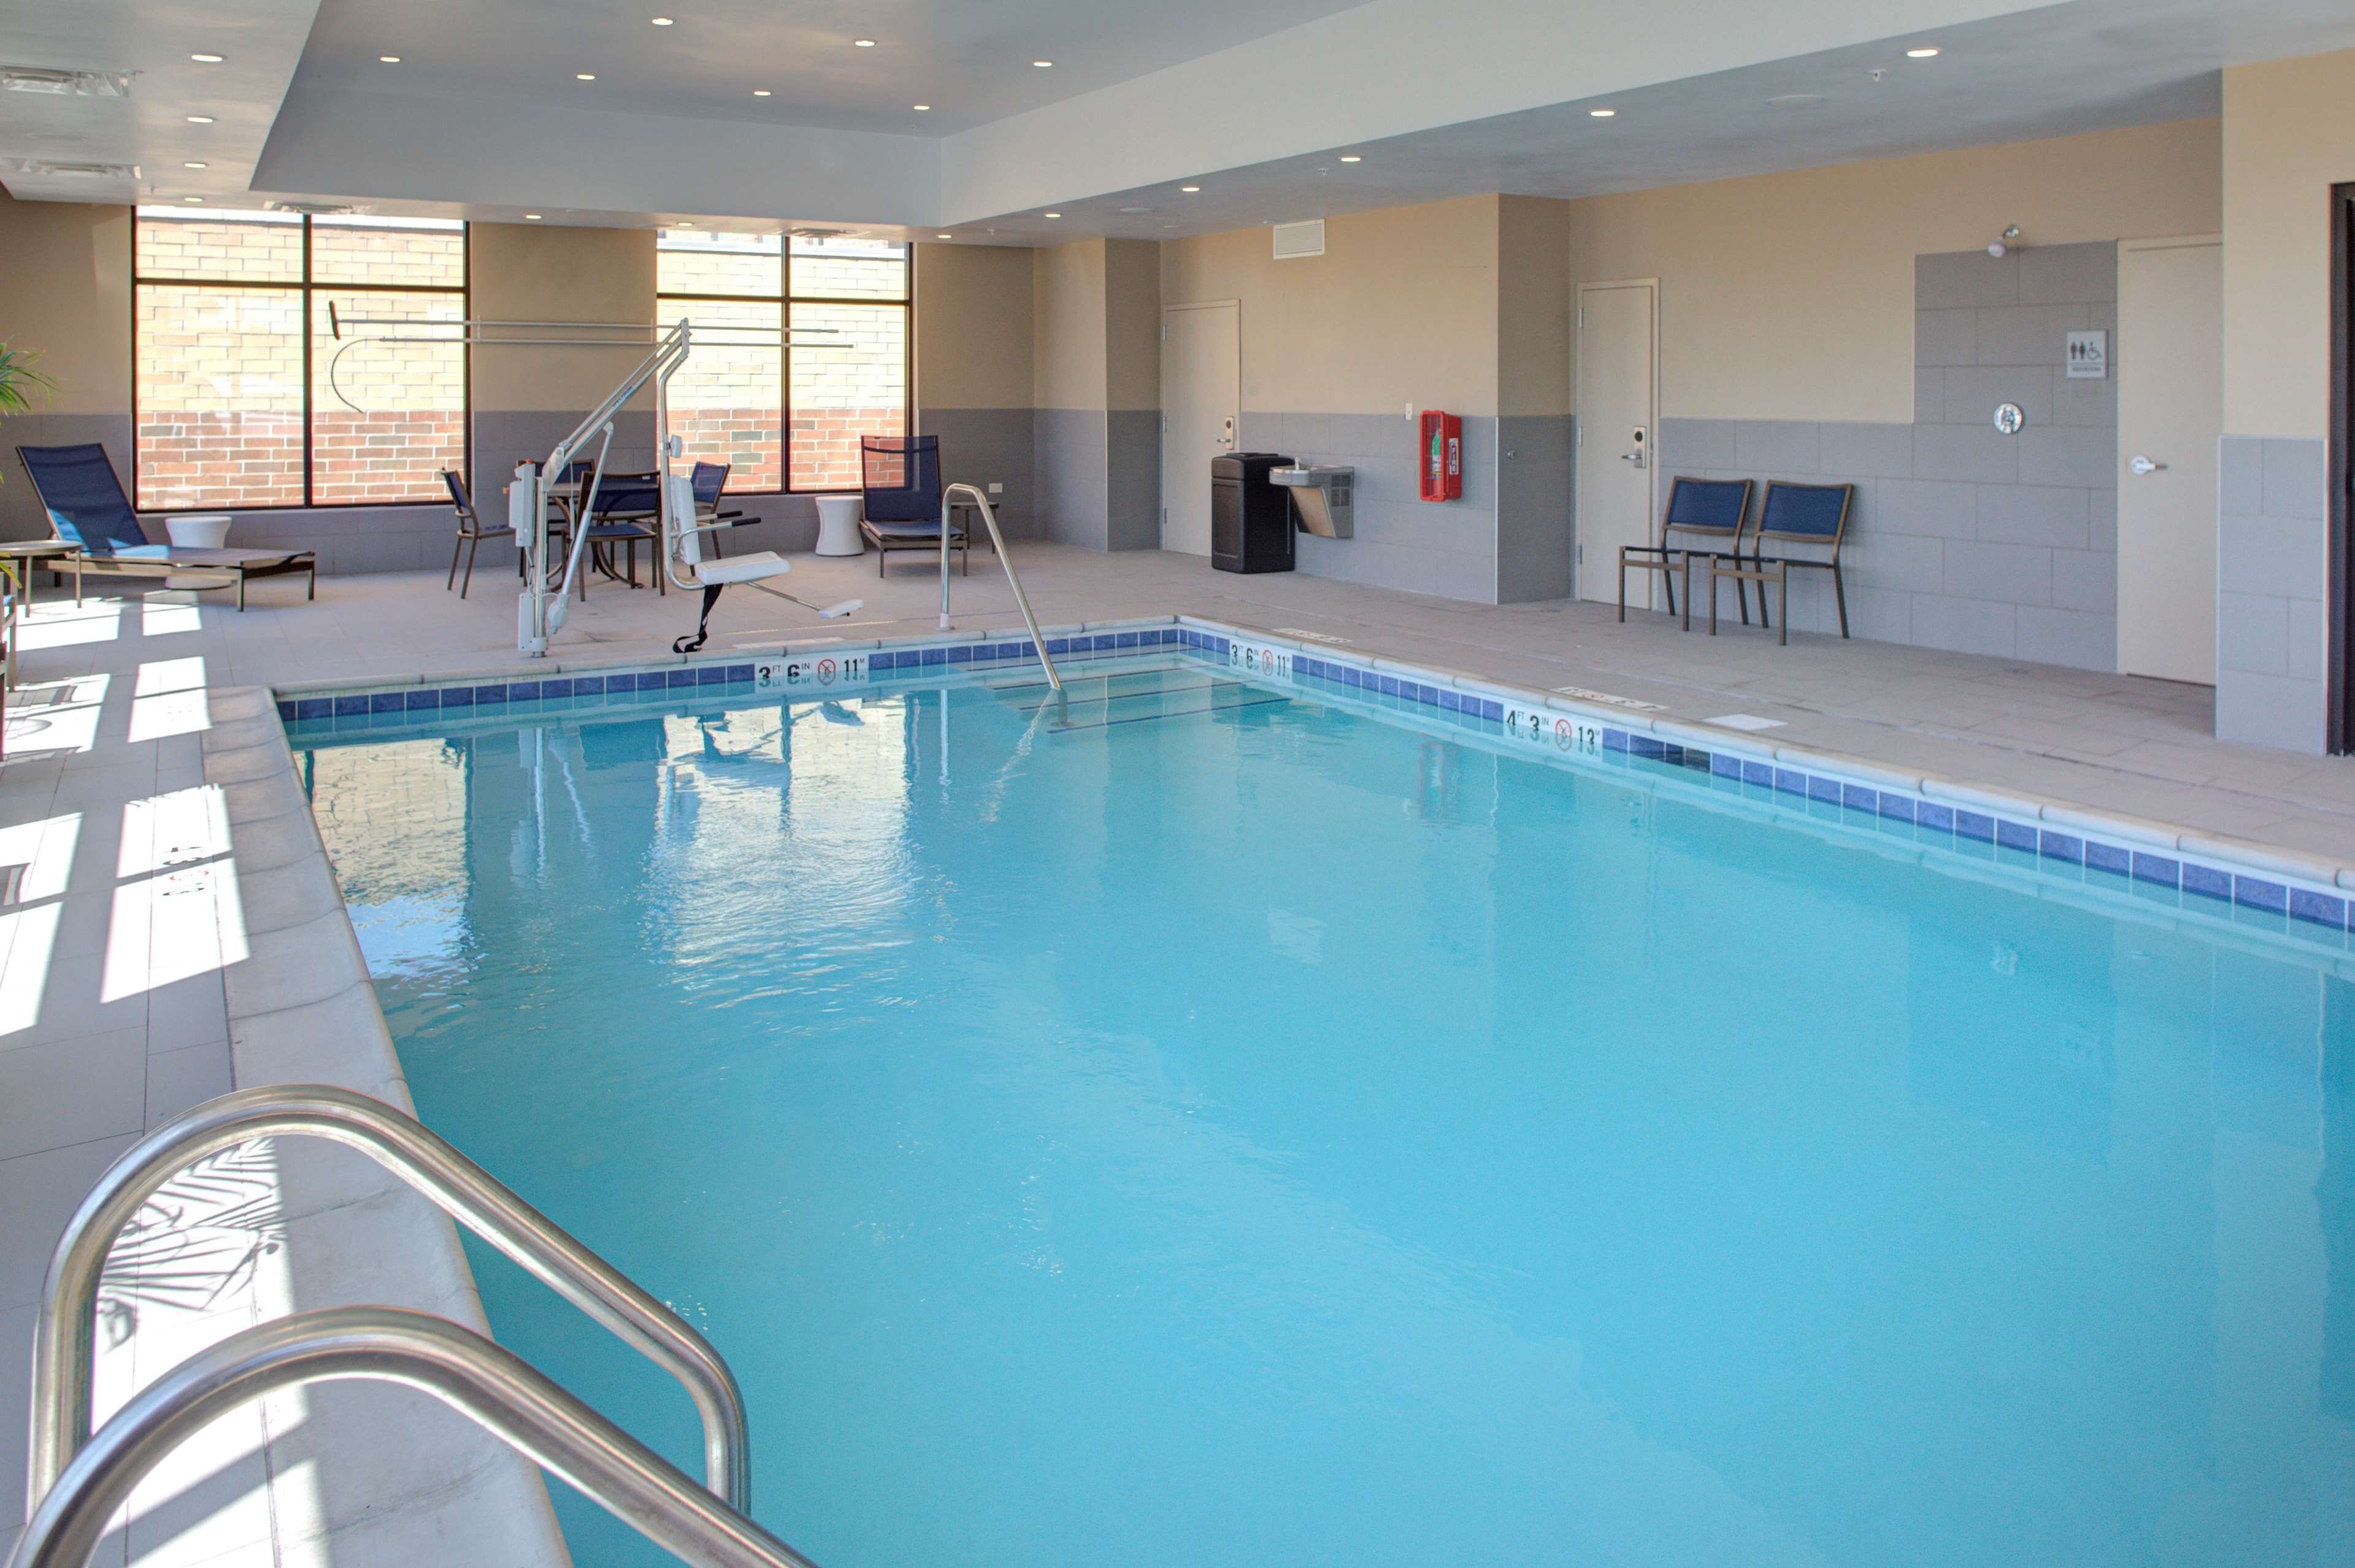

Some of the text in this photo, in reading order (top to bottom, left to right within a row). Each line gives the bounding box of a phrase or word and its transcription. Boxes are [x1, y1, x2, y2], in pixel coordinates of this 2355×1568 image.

[1232, 645, 1238, 658] 3
[1247, 648, 1253, 662] 6
[759, 666, 770, 680] 3
[787, 664, 800, 677] 6
[801, 662, 810, 671] IN
[1518, 711, 1525, 722] FT
[1530, 715, 1539, 731] 3
[1542, 716, 1550, 726] IN
